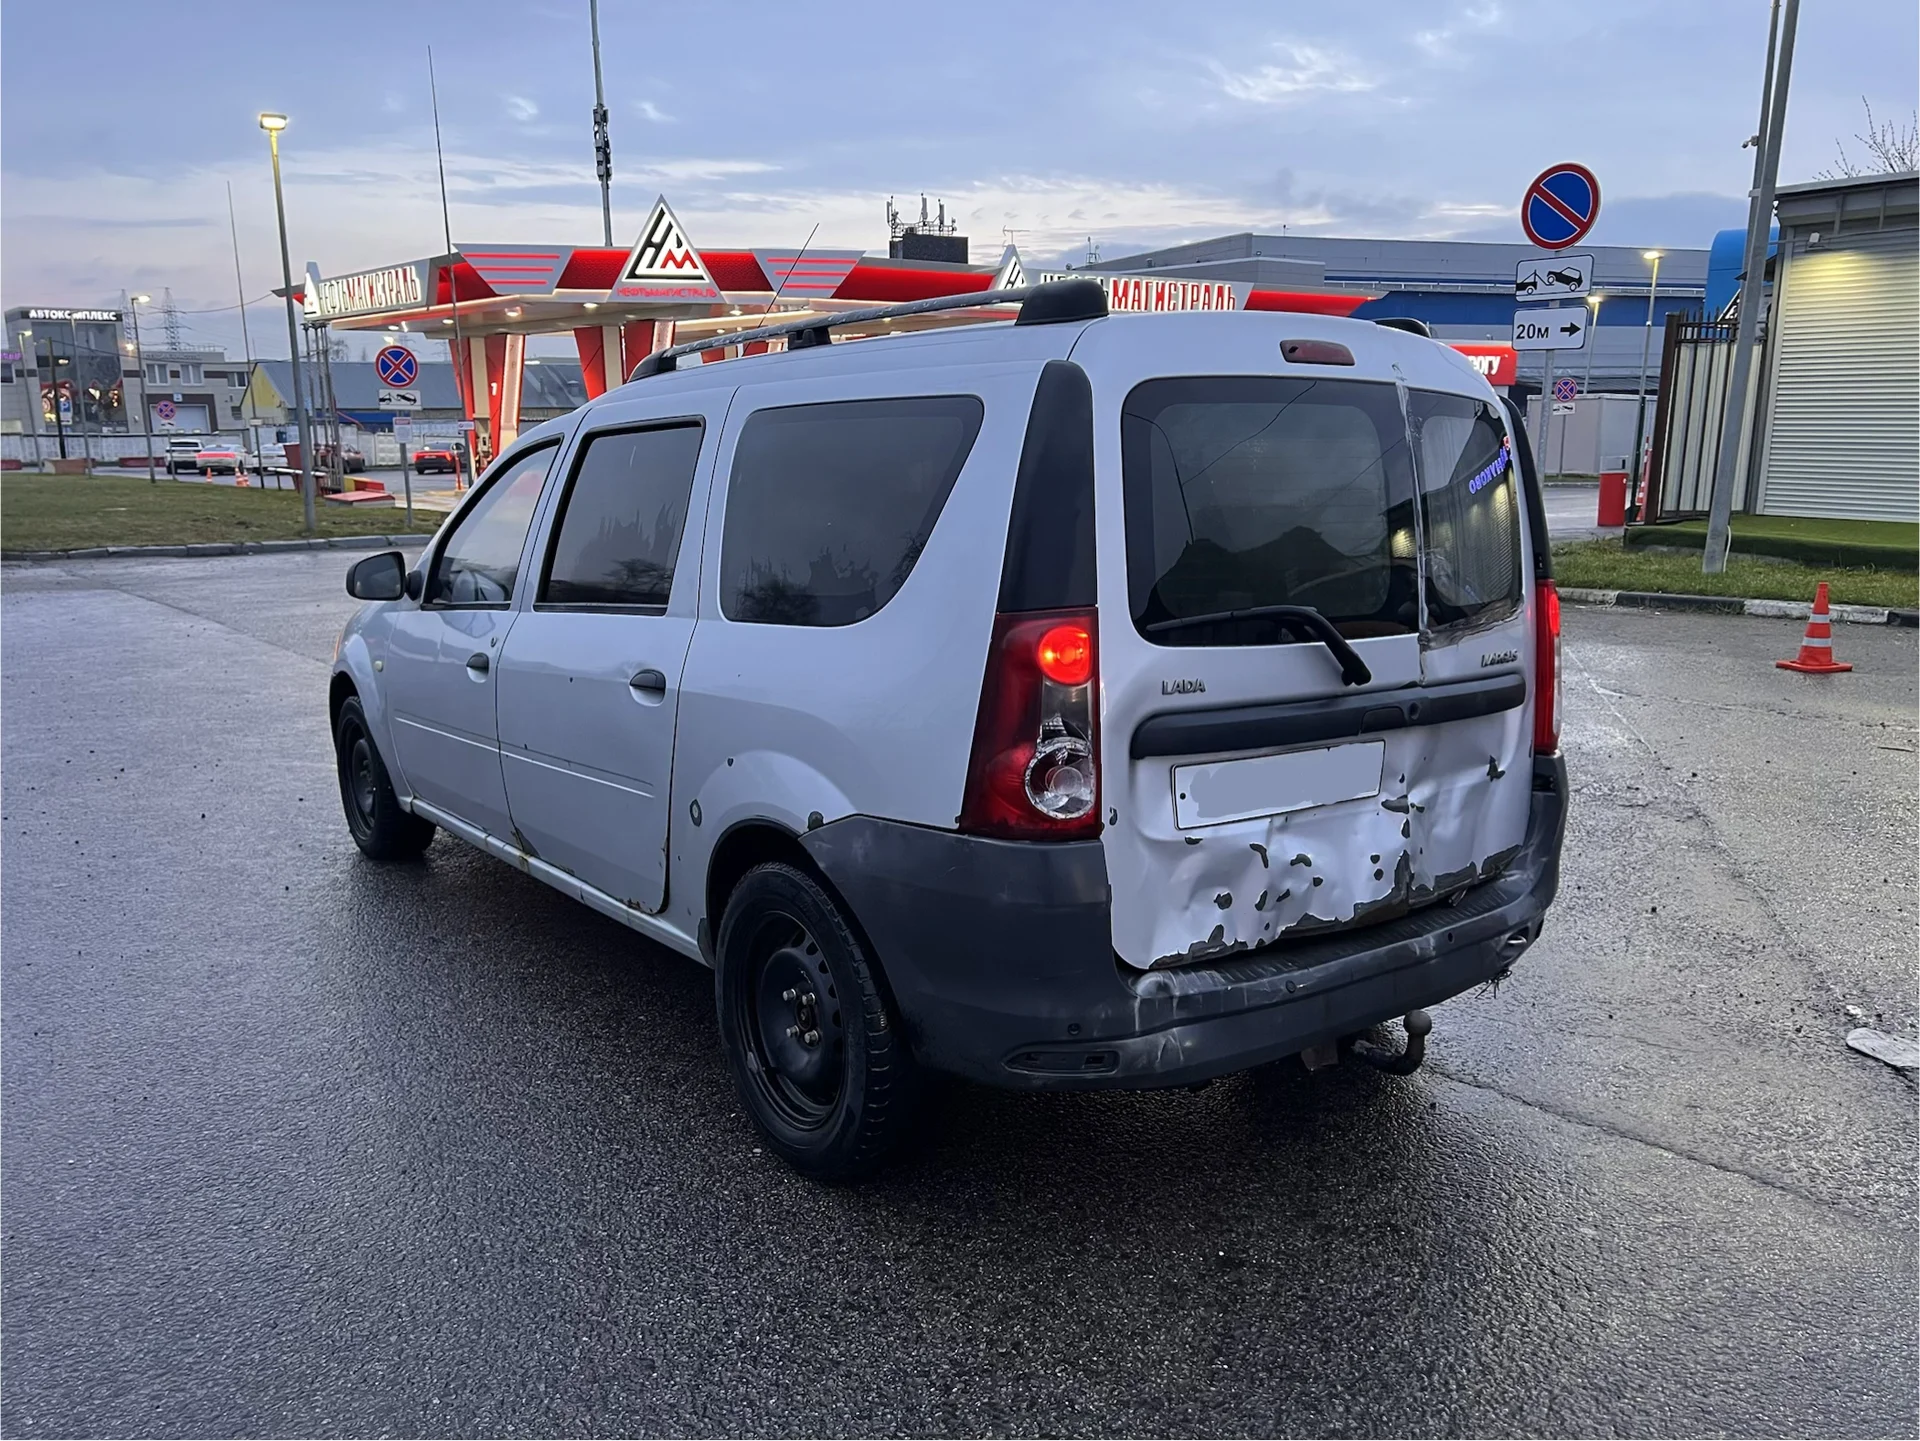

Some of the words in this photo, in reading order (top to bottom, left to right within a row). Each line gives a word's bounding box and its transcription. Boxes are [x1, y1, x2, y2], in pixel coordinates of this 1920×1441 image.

[318, 265, 422, 316] НЕФТЬМАГИСТРАЛЬ
[490, 382, 498, 396] 1
[1161, 678, 1206, 695] LADA
